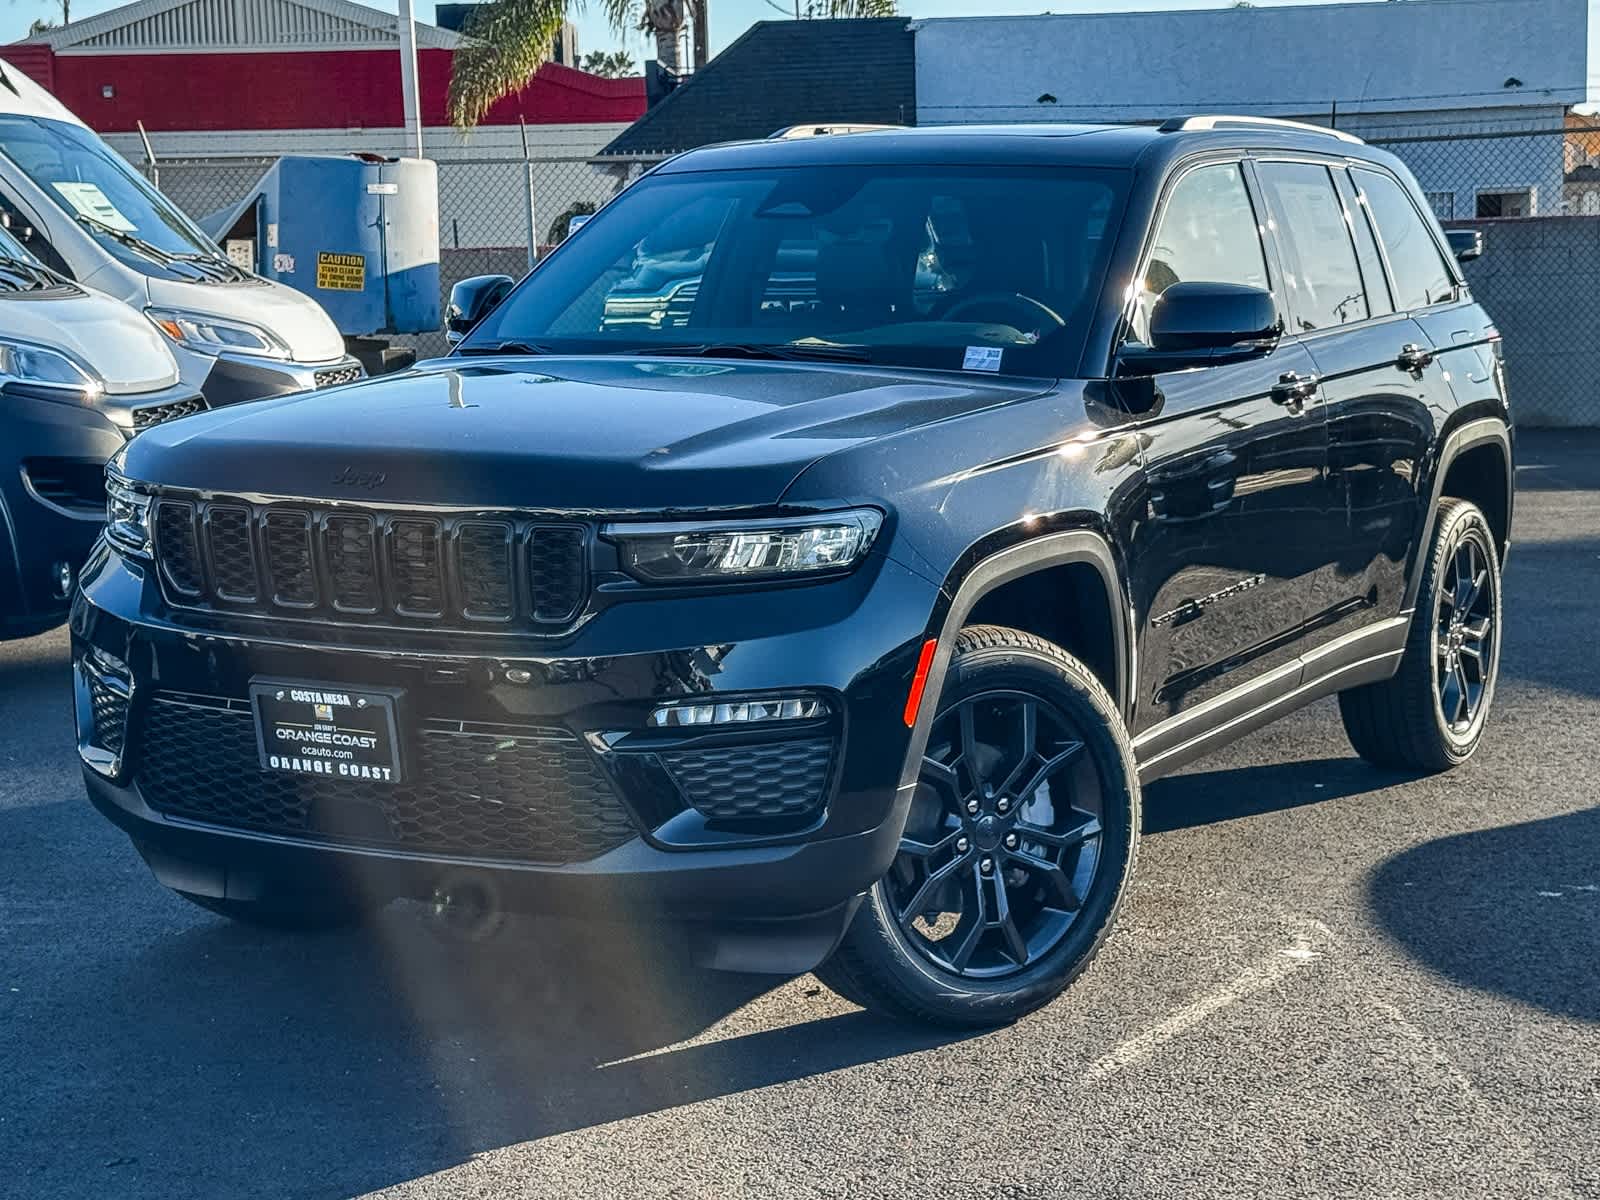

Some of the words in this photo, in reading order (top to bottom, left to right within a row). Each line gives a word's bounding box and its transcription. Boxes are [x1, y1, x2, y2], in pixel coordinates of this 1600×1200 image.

[320, 254, 362, 266] CAUTION
[290, 689, 322, 703] COSTA
[322, 693, 351, 706] MESA
[275, 728, 332, 744] ORANGE
[332, 734, 377, 749] COAST
[301, 746, 353, 759] ocauto.com
[270, 756, 333, 773] ORANGE
[339, 763, 391, 780] COAST
